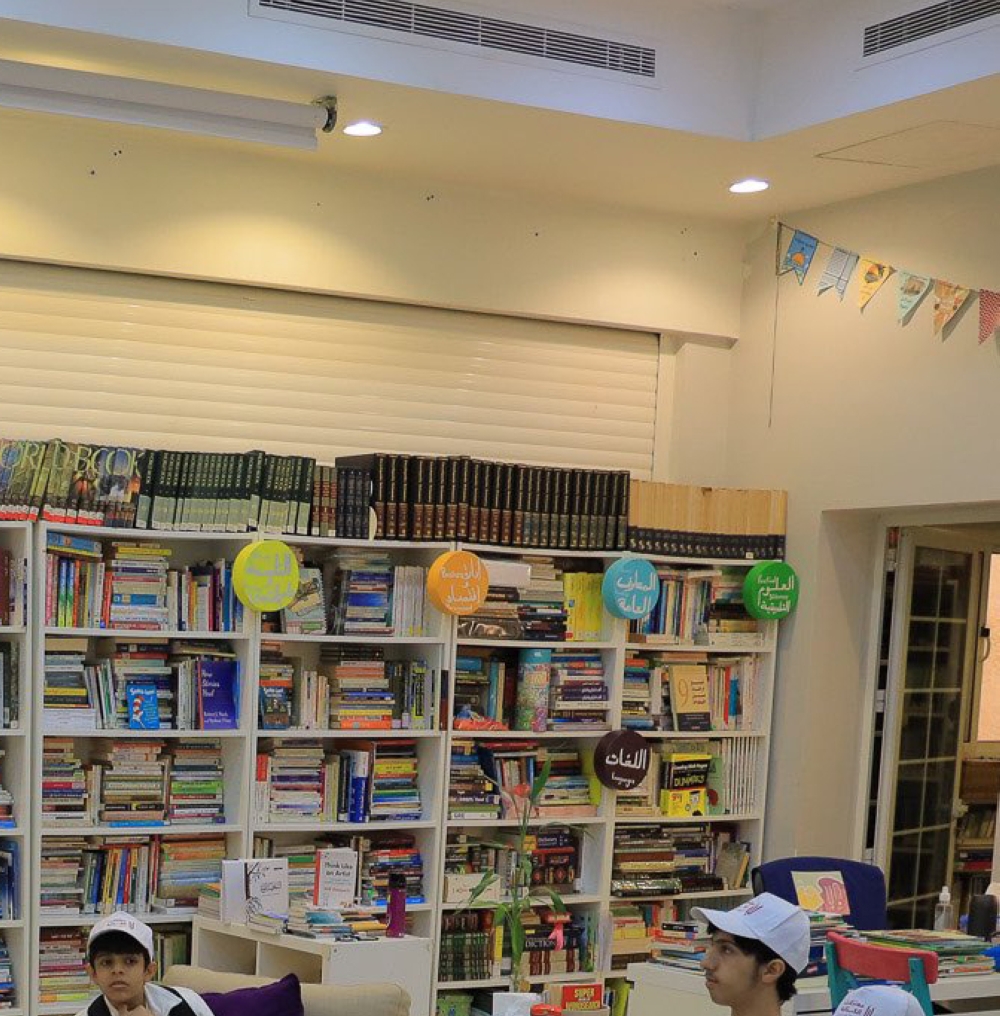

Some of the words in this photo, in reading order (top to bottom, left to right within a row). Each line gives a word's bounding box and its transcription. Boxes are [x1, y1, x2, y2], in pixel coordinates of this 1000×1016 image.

[74, 446, 147, 479] BOOK
[617, 570, 656, 591] المعارف
[758, 574, 794, 607] العلوم
[605, 748, 647, 770] اللغات
[673, 775, 705, 787] DUMMIES
